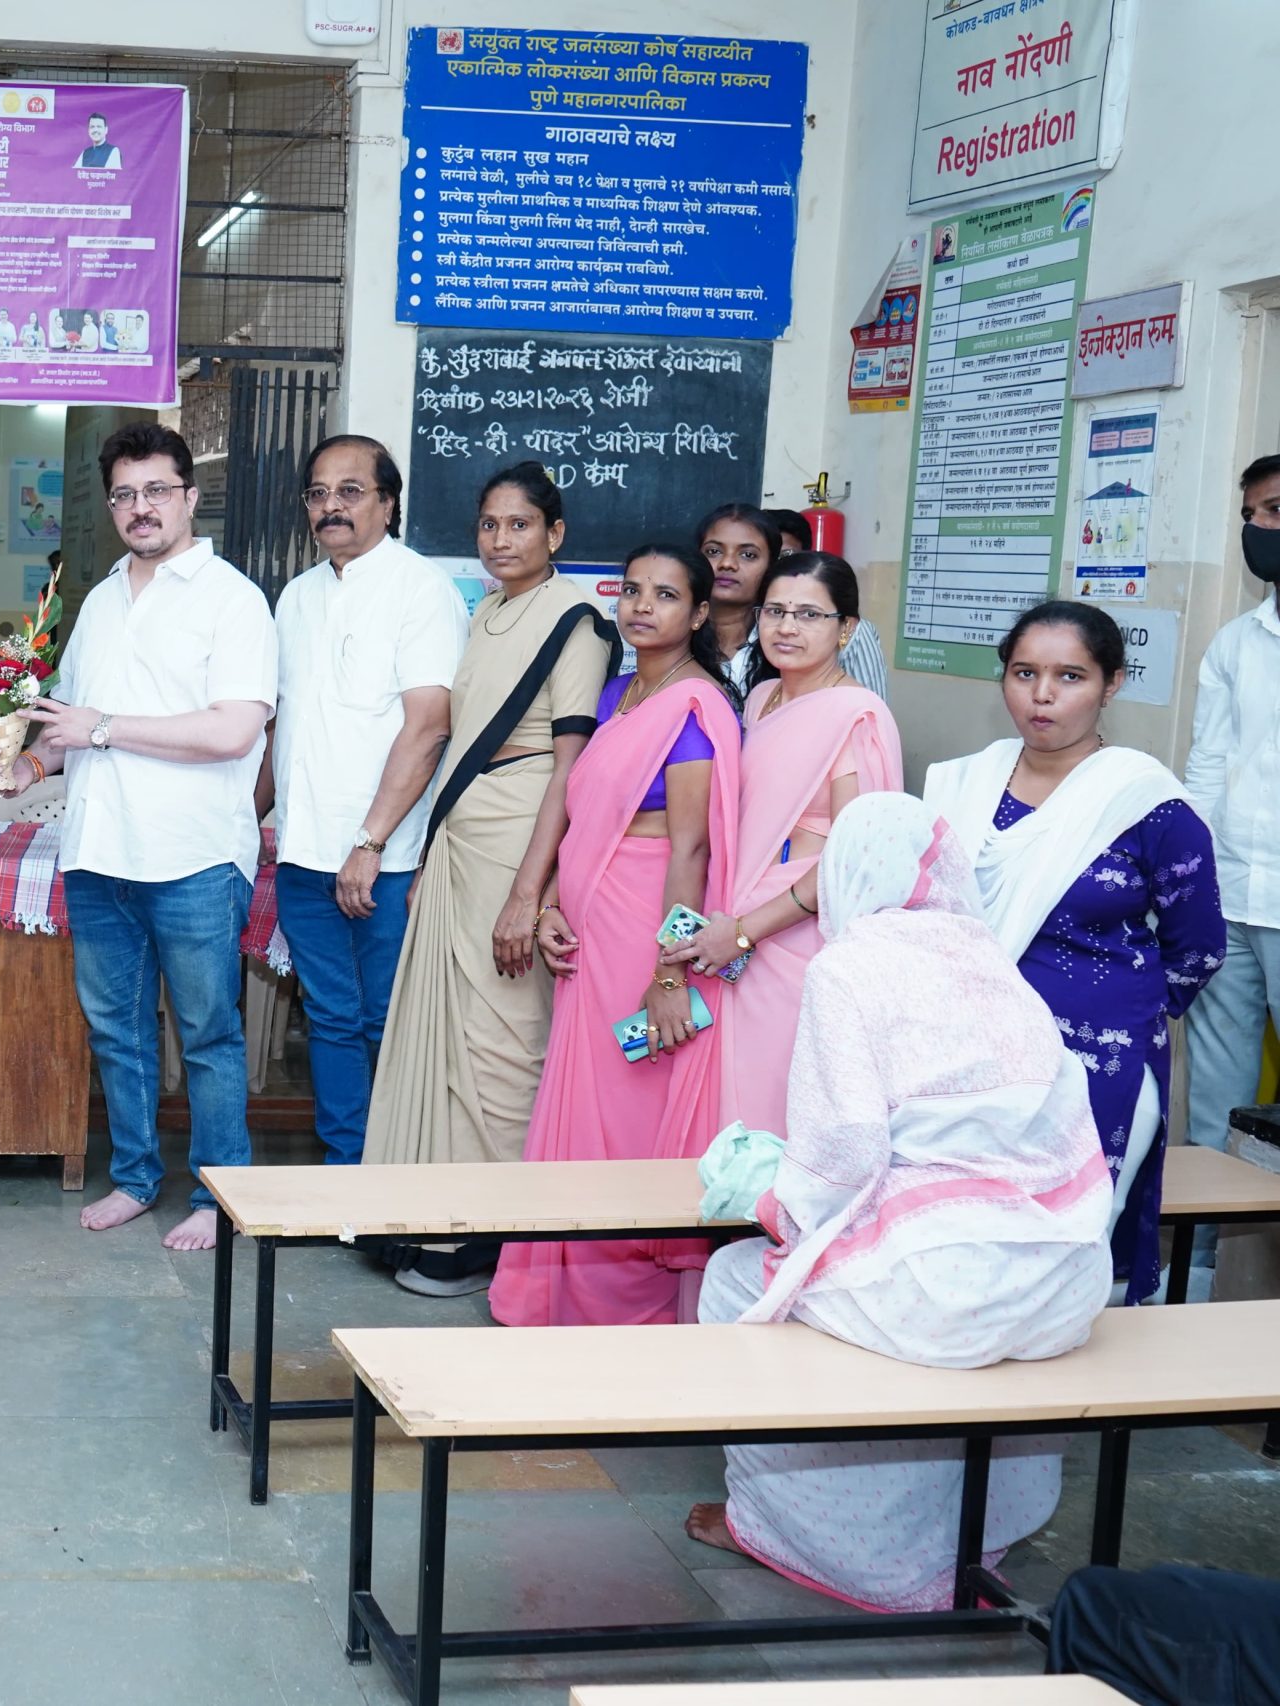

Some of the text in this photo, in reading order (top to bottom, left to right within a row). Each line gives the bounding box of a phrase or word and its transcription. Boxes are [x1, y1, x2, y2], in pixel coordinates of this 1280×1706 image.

[526, 36, 559, 54] राष्ट्र
[644, 36, 679, 56] कोष
[957, 21, 1073, 96] नाव नोंदणी
[447, 56, 771, 88] एकात्मिक लोकसंख्या आणि विकास प्रकल्प
[530, 85, 687, 111] पुणे महानगरपालिका
[14, 124, 35, 134] विभाग
[635, 131, 676, 148] लक्ष्य
[441, 145, 589, 166] कुटुंब लहान सुख महान
[937, 109, 1075, 177] Registration
[440, 167, 477, 181] लग्नाचे
[480, 168, 508, 185] वेळी,
[515, 170, 549, 188] मुलीचे
[555, 175, 573, 185] वय
[578, 176, 592, 188] १८
[596, 173, 618, 188] पेक्षा
[621, 178, 630, 188] व
[633, 176, 666, 193] मुलाचे
[671, 180, 684, 192] २१
[735, 180, 758, 194] कमी
[761, 181, 795, 197] नसावे.
[439, 187, 474, 202] प्रत्येक
[477, 190, 518, 207] मुलीला
[522, 192, 569, 206] प्राथमिक
[573, 198, 582, 208] व
[586, 195, 639, 211] माध्यमिक
[643, 197, 679, 213] शिक्षण
[682, 199, 702, 214] देणे
[439, 212, 472, 227] मुलगा
[476, 210, 506, 225] किंवा
[509, 213, 543, 230] मुलगी
[547, 213, 571, 228] लिंग
[575, 216, 592, 231] भेद
[662, 220, 709, 235] सारखेच.
[437, 230, 472, 245] प्रत्येक
[476, 233, 532, 248] जन्मलेल्या
[536, 239, 594, 250] अपत्याच्या
[662, 241, 688, 255] हमी.
[436, 251, 673, 275] स्त्री केंद्रीत प्रजनन आरोग्य कार्यक्रम राबविणे.
[435, 272, 768, 301] प्रत्येक स्त्रीला प्रजनन क्षमतेचे अधिकार वापरण्यास सक्षम करणे.
[435, 293, 757, 320] लैंगिक आणि प्रजनन आजारांबाबत आरोग्य शिक्षण व उपचार.
[660, 344, 742, 377] दवाखाना
[417, 375, 653, 417] दिनांक रोजी
[588, 422, 740, 460] आरोग्य शिबिर
